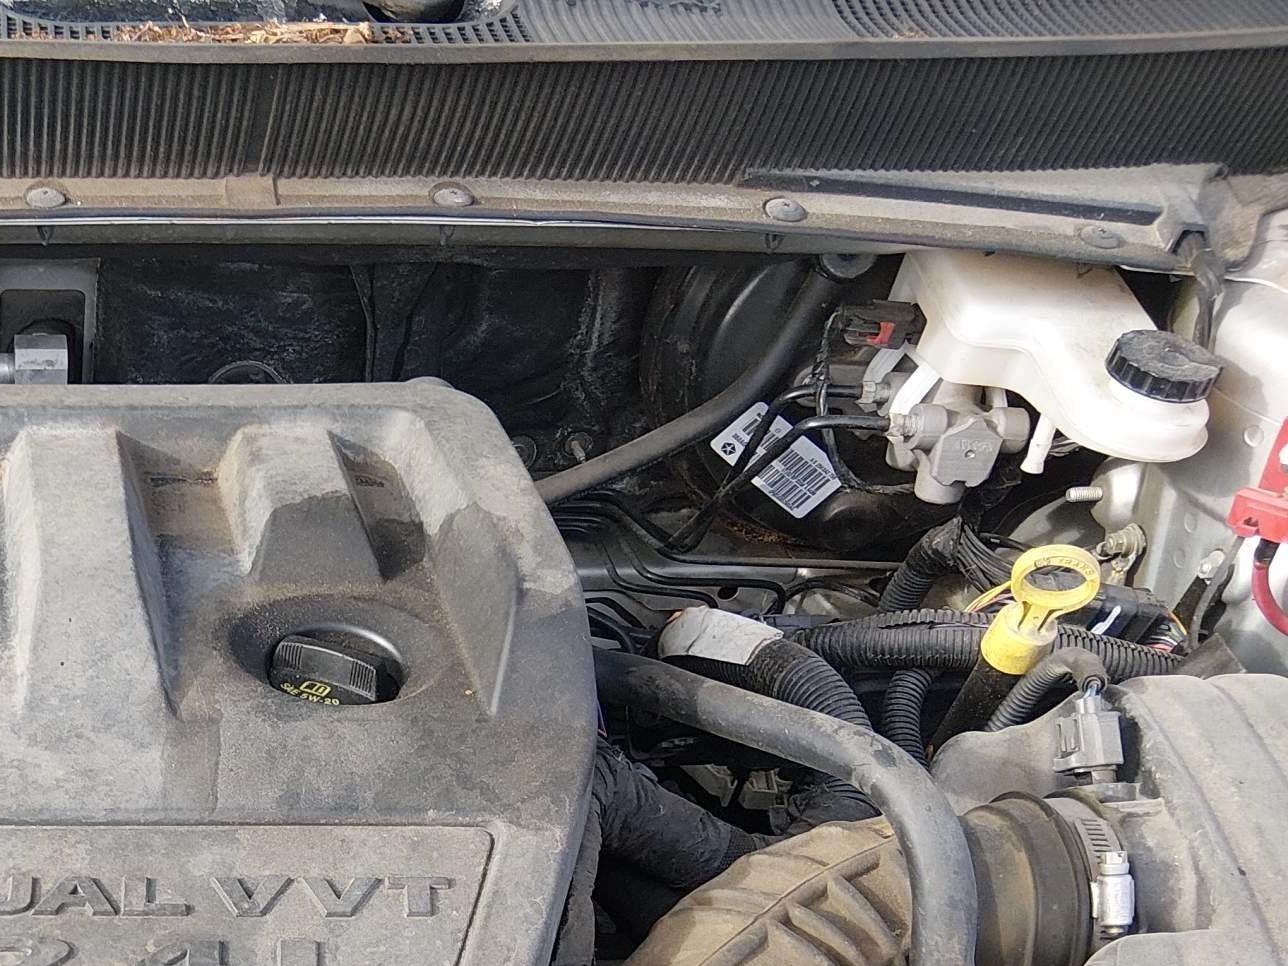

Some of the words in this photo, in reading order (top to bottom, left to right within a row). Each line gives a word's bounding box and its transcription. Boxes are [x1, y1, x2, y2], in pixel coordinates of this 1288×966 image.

[280, 682, 301, 696] SAE
[300, 692, 340, 706] 5W-20
[212, 874, 457, 918] VVT
